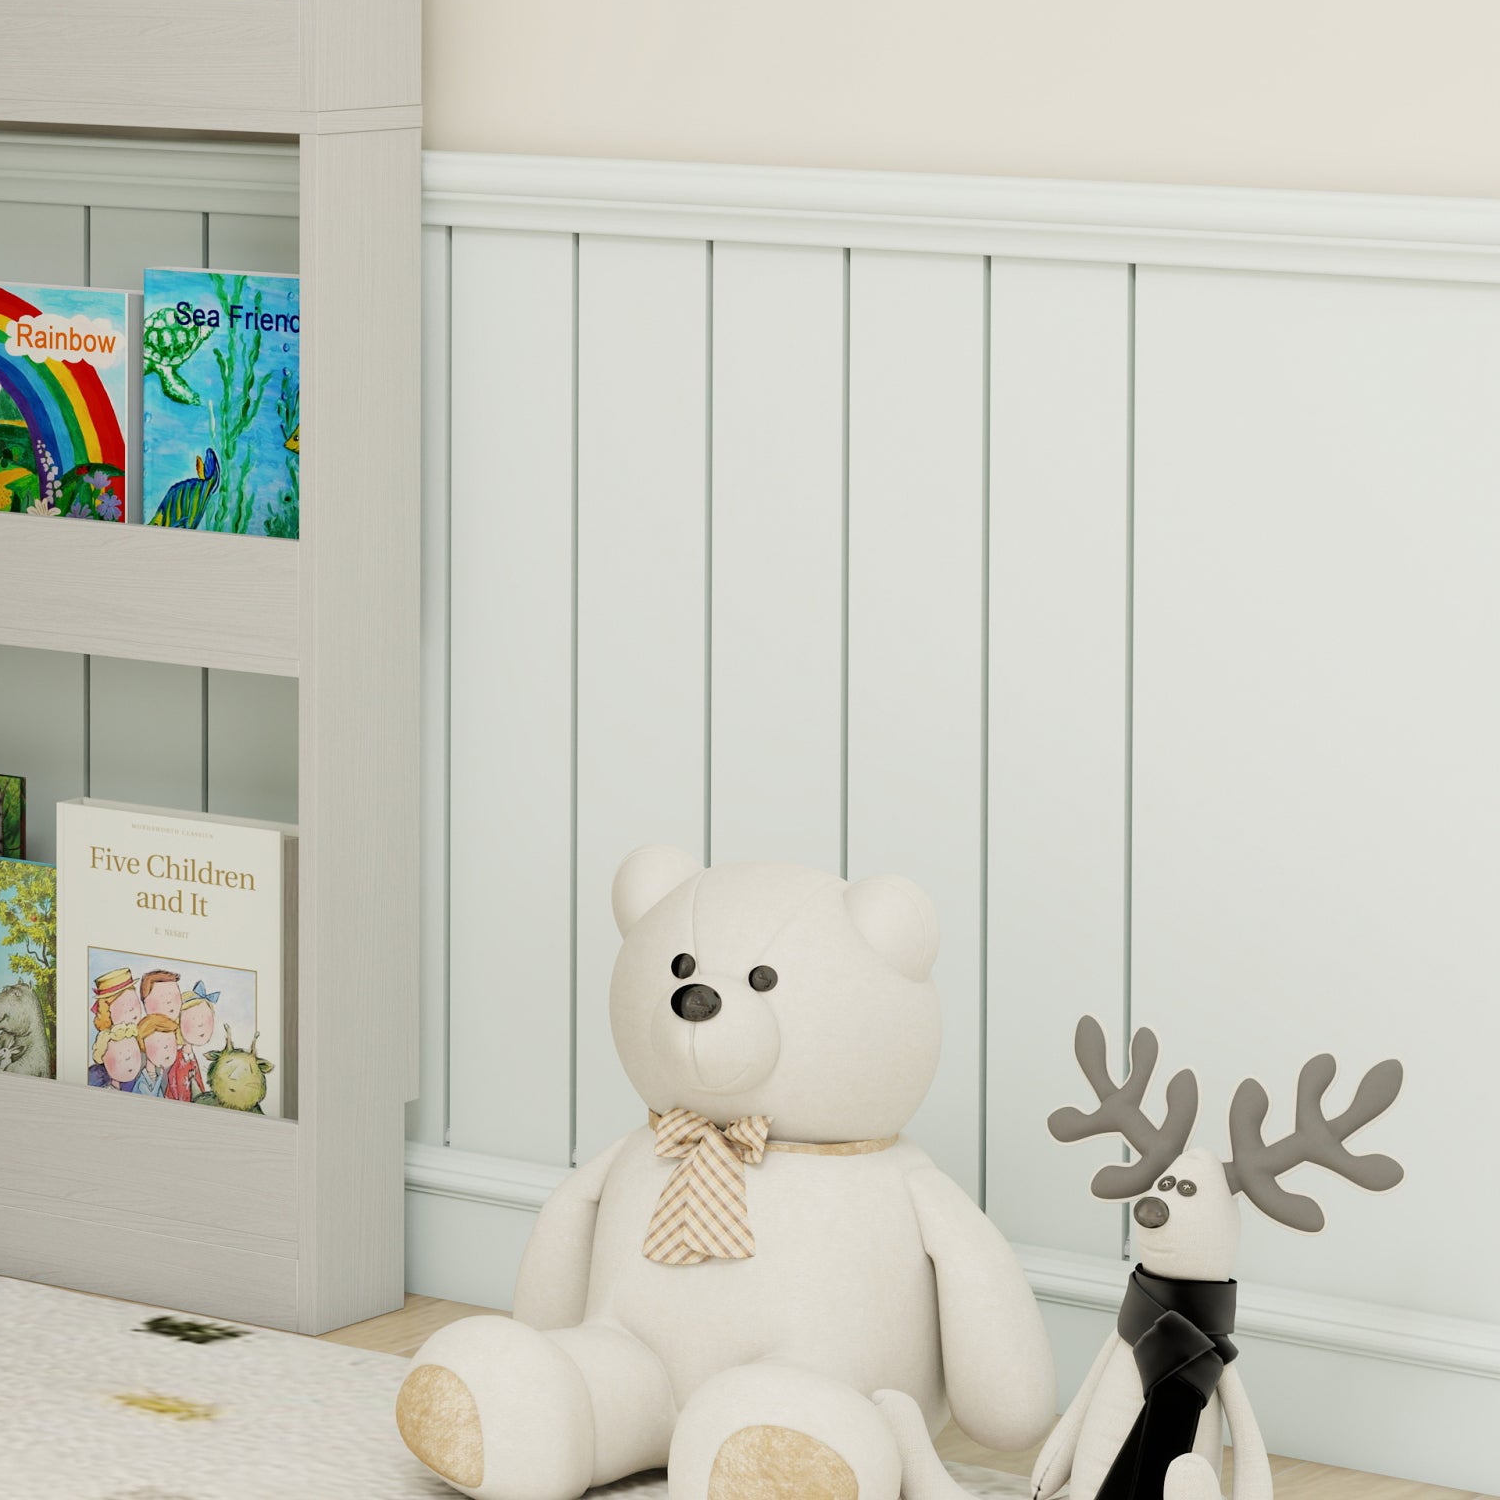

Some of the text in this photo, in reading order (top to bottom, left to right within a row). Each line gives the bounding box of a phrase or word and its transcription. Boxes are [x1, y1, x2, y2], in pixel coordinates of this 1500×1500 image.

[175, 301, 220, 328] Sea
[16, 323, 117, 354] Rainbow
[89, 846, 257, 891] Five Children
[136, 889, 209, 918] and It
